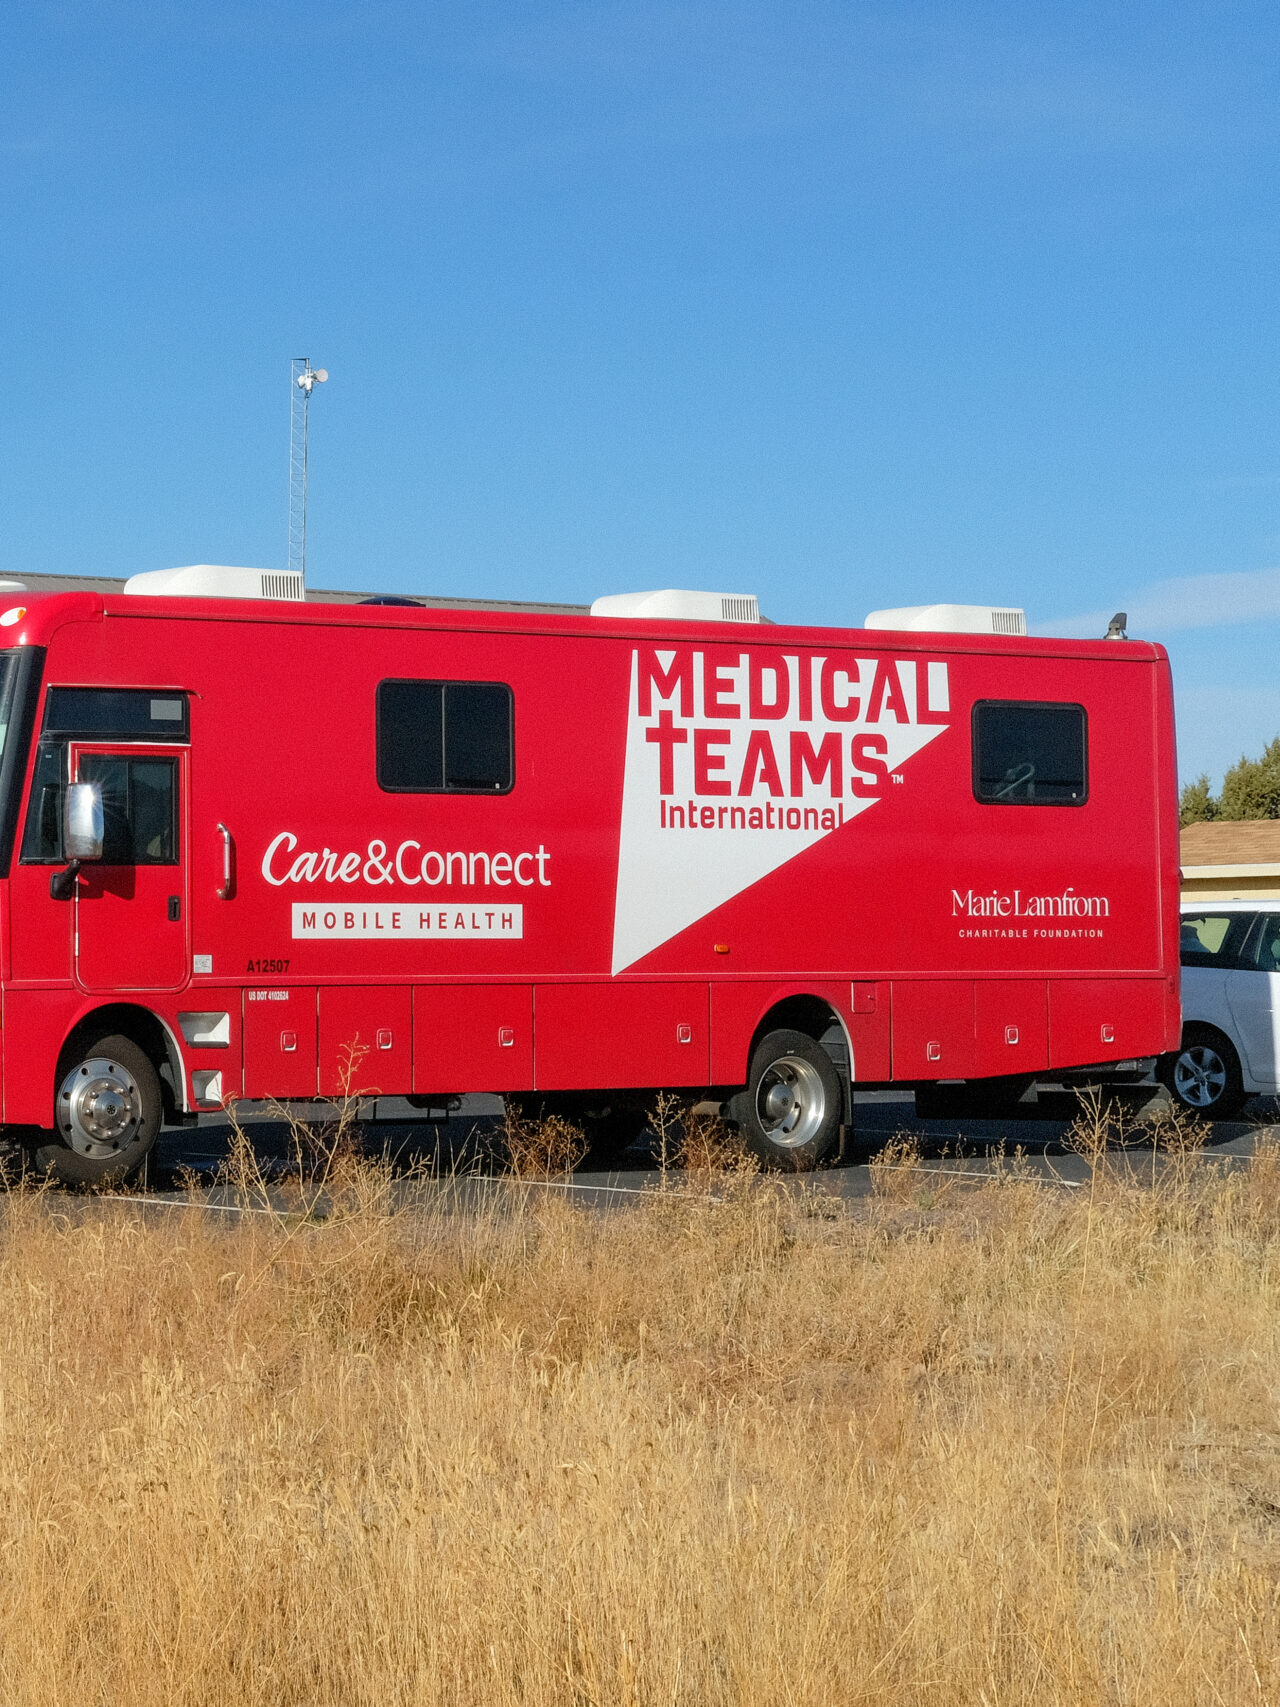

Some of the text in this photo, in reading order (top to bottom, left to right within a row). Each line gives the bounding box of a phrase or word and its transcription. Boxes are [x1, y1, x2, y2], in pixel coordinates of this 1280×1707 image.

[637, 649, 950, 724] MEDICAL
[645, 709, 889, 798] TEAMS
[660, 799, 844, 831] International
[261, 831, 552, 886] Care&Connect
[951, 887, 1110, 917] Marie Lamfrom
[302, 911, 514, 930] MOBILE HEALTH
[958, 929, 1104, 938] CHARITABLE FOUNDATION
[247, 959, 290, 972] A12507
[248, 991, 256, 1001] US
[256, 991, 268, 1001] DOT
